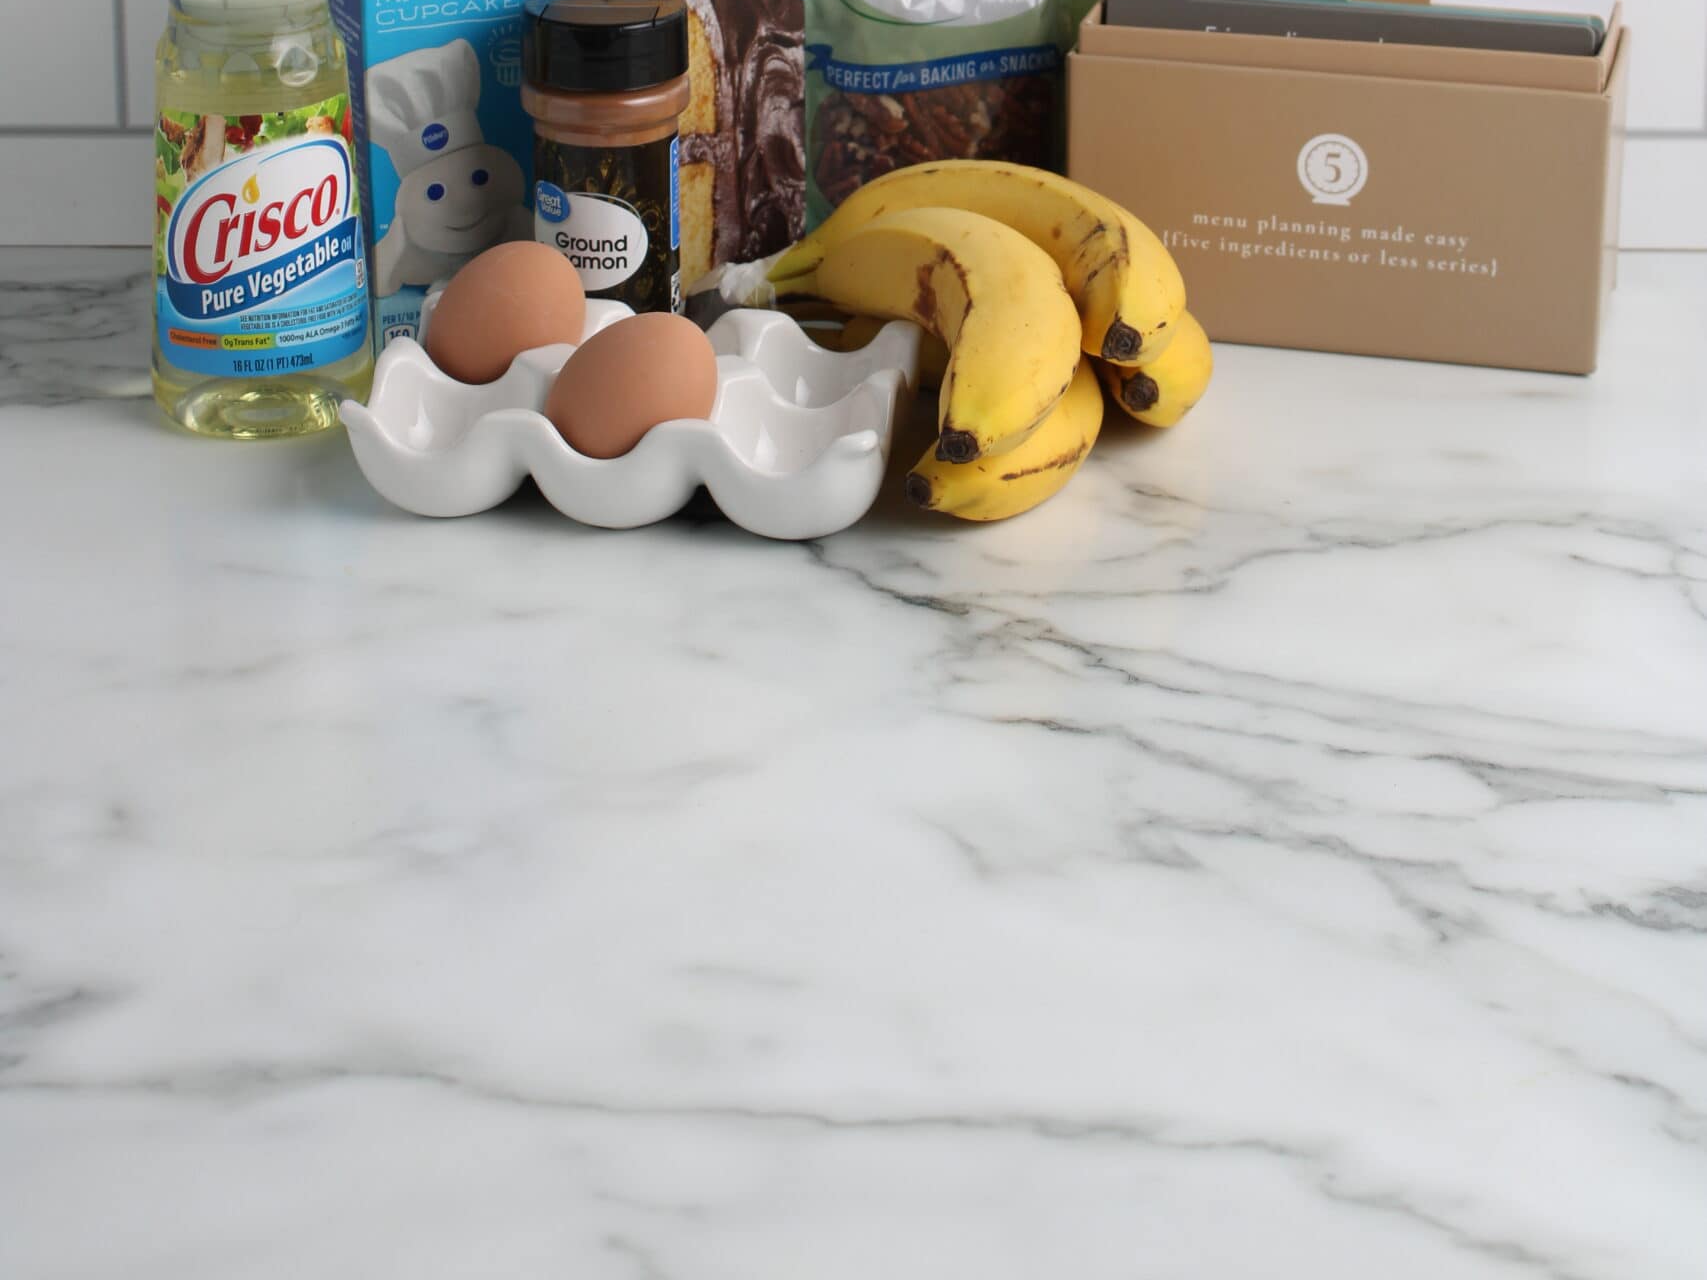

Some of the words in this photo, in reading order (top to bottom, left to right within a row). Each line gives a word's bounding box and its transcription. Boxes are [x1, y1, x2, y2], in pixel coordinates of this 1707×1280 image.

[826, 65, 890, 89] PERFECT
[892, 70, 916, 89] for
[921, 60, 976, 85] BAKING
[1323, 152, 1342, 183] 5
[184, 174, 338, 284] Crisco
[555, 232, 628, 252] Ground
[1193, 212, 1248, 228] menu
[1257, 215, 1352, 241] planning
[1361, 226, 1415, 243] made
[1424, 232, 1470, 252] easy
[1163, 229, 1211, 250] {five
[1219, 237, 1341, 262] ingredients
[1348, 251, 1370, 263] or
[1380, 249, 1418, 269] less
[1427, 258, 1499, 277] series}
[202, 285, 244, 315] Pure
[247, 235, 339, 297] Vegetable
[341, 234, 352, 253] Oil
[234, 337, 253, 346] Trans
[279, 334, 304, 343] 1000mg
[305, 330, 319, 338] ALA
[233, 360, 242, 372] 16
[244, 360, 253, 372] FL
[255, 359, 264, 371] OZ
